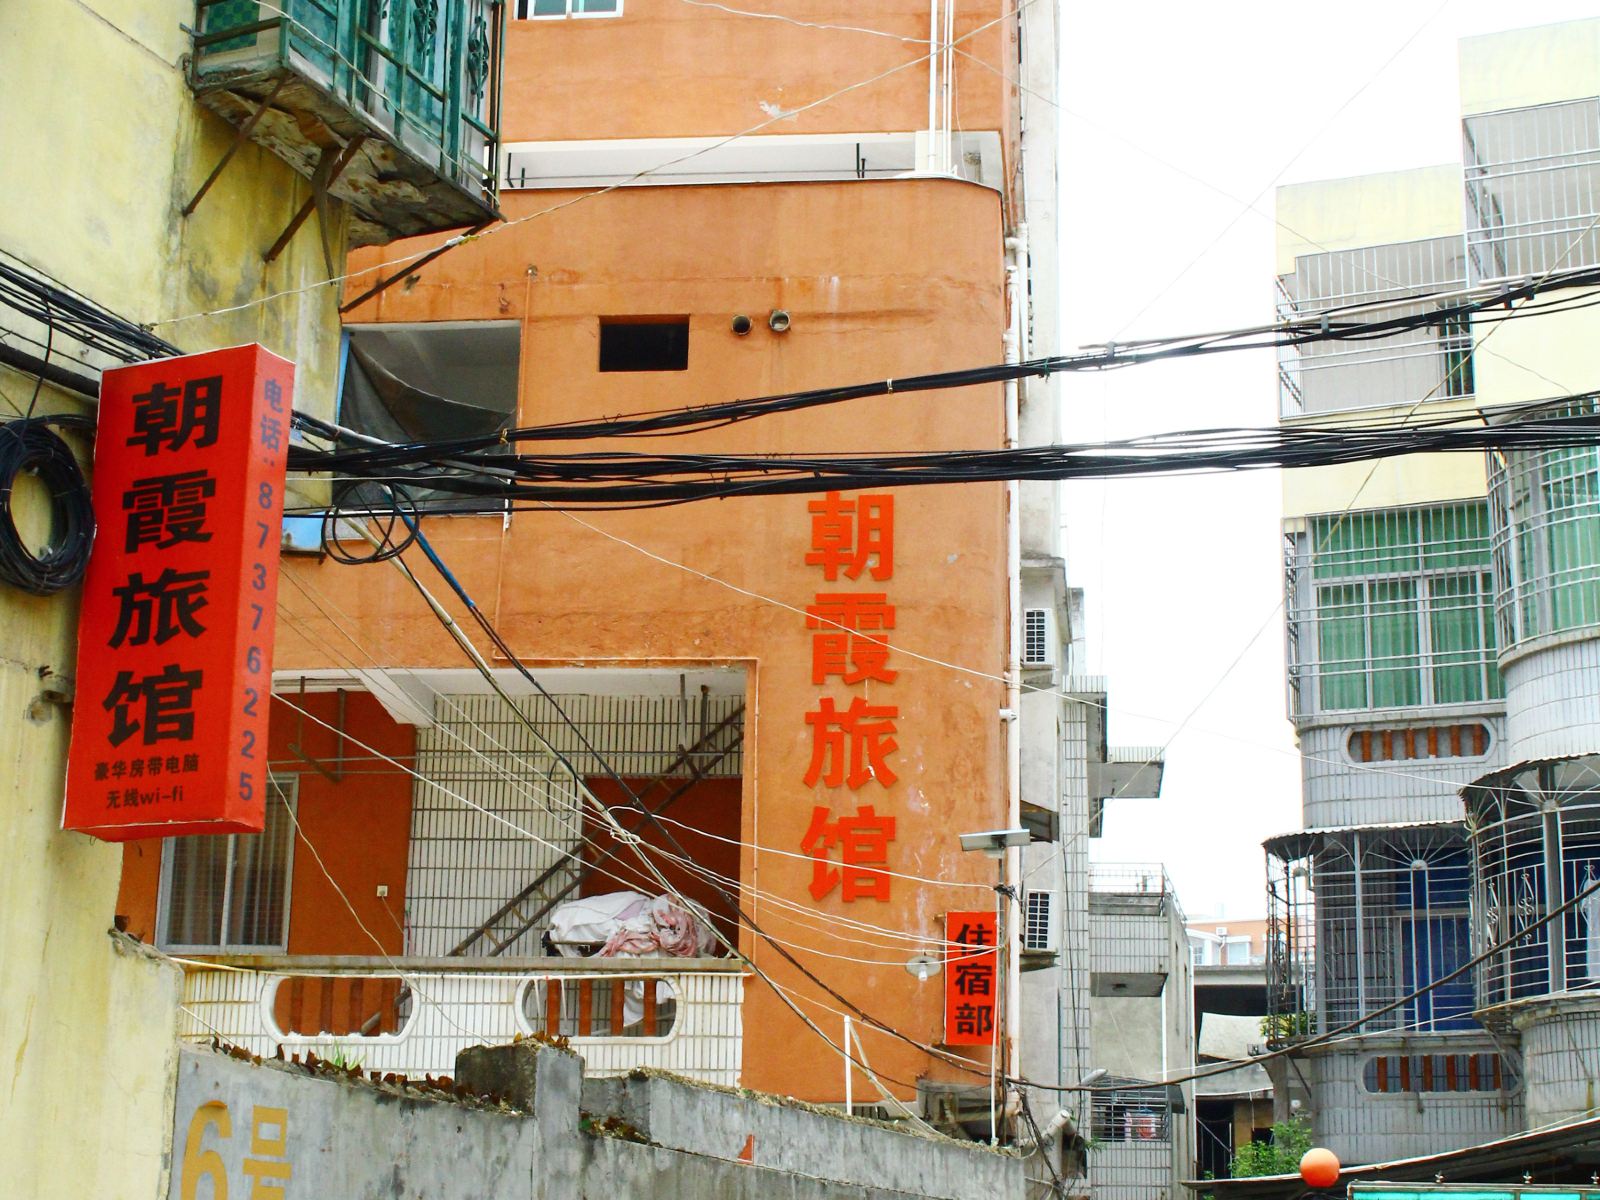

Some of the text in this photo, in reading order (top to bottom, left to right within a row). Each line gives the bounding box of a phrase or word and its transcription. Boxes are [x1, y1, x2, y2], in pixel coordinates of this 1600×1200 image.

[102, 375, 223, 748] 朝霞旅馆
[801, 491, 898, 902] 朝霞旅馆
[94, 753, 199, 781] 豪华房带电脑
[954, 923, 993, 1037] 住宿部
[180, 1100, 292, 1200] 6号
